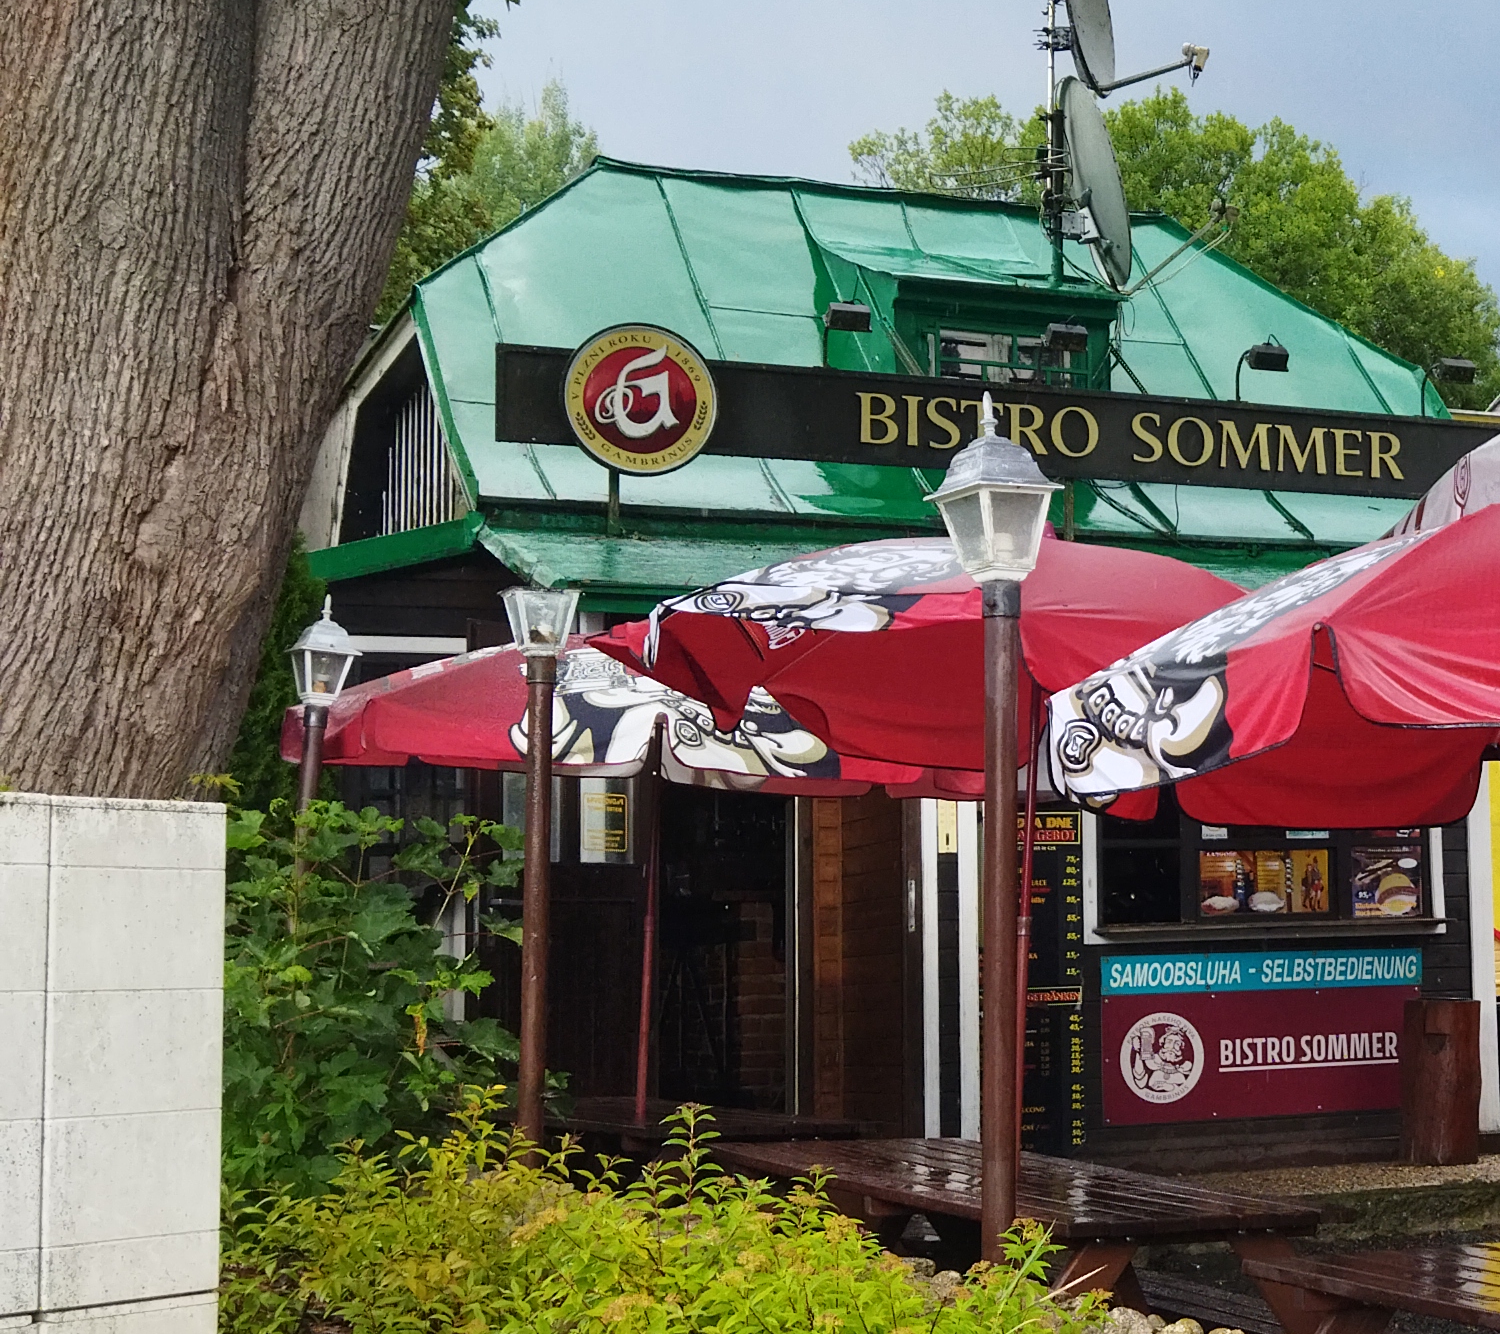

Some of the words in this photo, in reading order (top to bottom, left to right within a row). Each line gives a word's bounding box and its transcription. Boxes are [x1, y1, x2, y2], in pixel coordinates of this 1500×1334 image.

[608, 334, 652, 348] ROKU
[574, 347, 605, 385] PLZNI
[675, 351, 701, 382] 1869
[572, 391, 580, 401] V
[601, 436, 693, 466] GAMBRINUS
[1132, 412, 1404, 480] SOMMER
[1017, 829, 1076, 841] AGEBOT
[1109, 961, 1241, 988] SAMOOBSLUHA
[1261, 955, 1417, 983] SELBSTBEDIENUNG
[1220, 1037, 1295, 1065] BISTRO
[1300, 1032, 1398, 1061] SOMMER
[1144, 1086, 1189, 1100] GAMBRINUS
